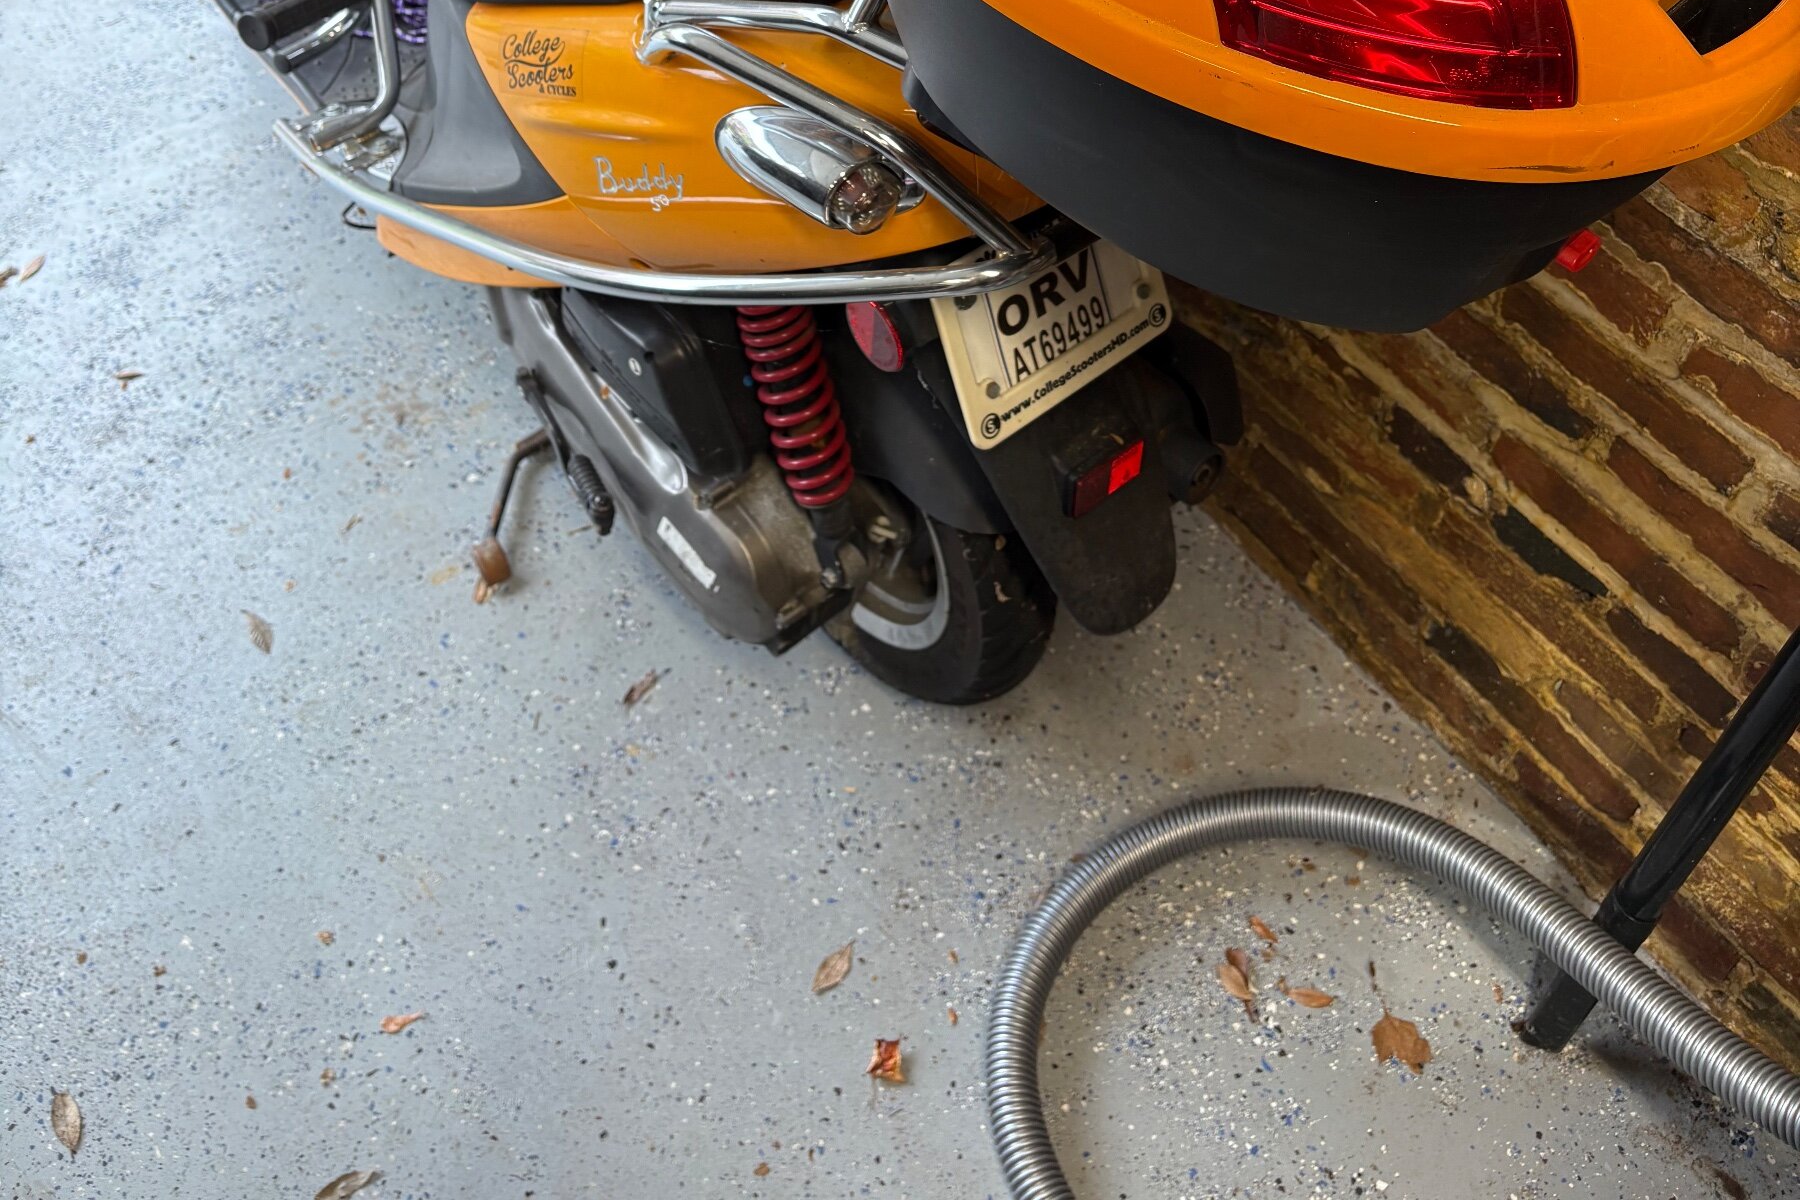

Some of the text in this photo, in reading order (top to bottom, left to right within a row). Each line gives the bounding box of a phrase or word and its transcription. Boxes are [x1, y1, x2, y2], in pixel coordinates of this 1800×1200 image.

[503, 30, 564, 62] College
[507, 57, 574, 89] Scooters
[547, 84, 577, 97] CYCLES
[592, 156, 684, 200] Buddy
[650, 194, 670, 212] 50
[997, 247, 1089, 336] ORV
[1012, 296, 1106, 383] AT69499
[1000, 318, 1149, 423] www.CollegeScootersMD.com
